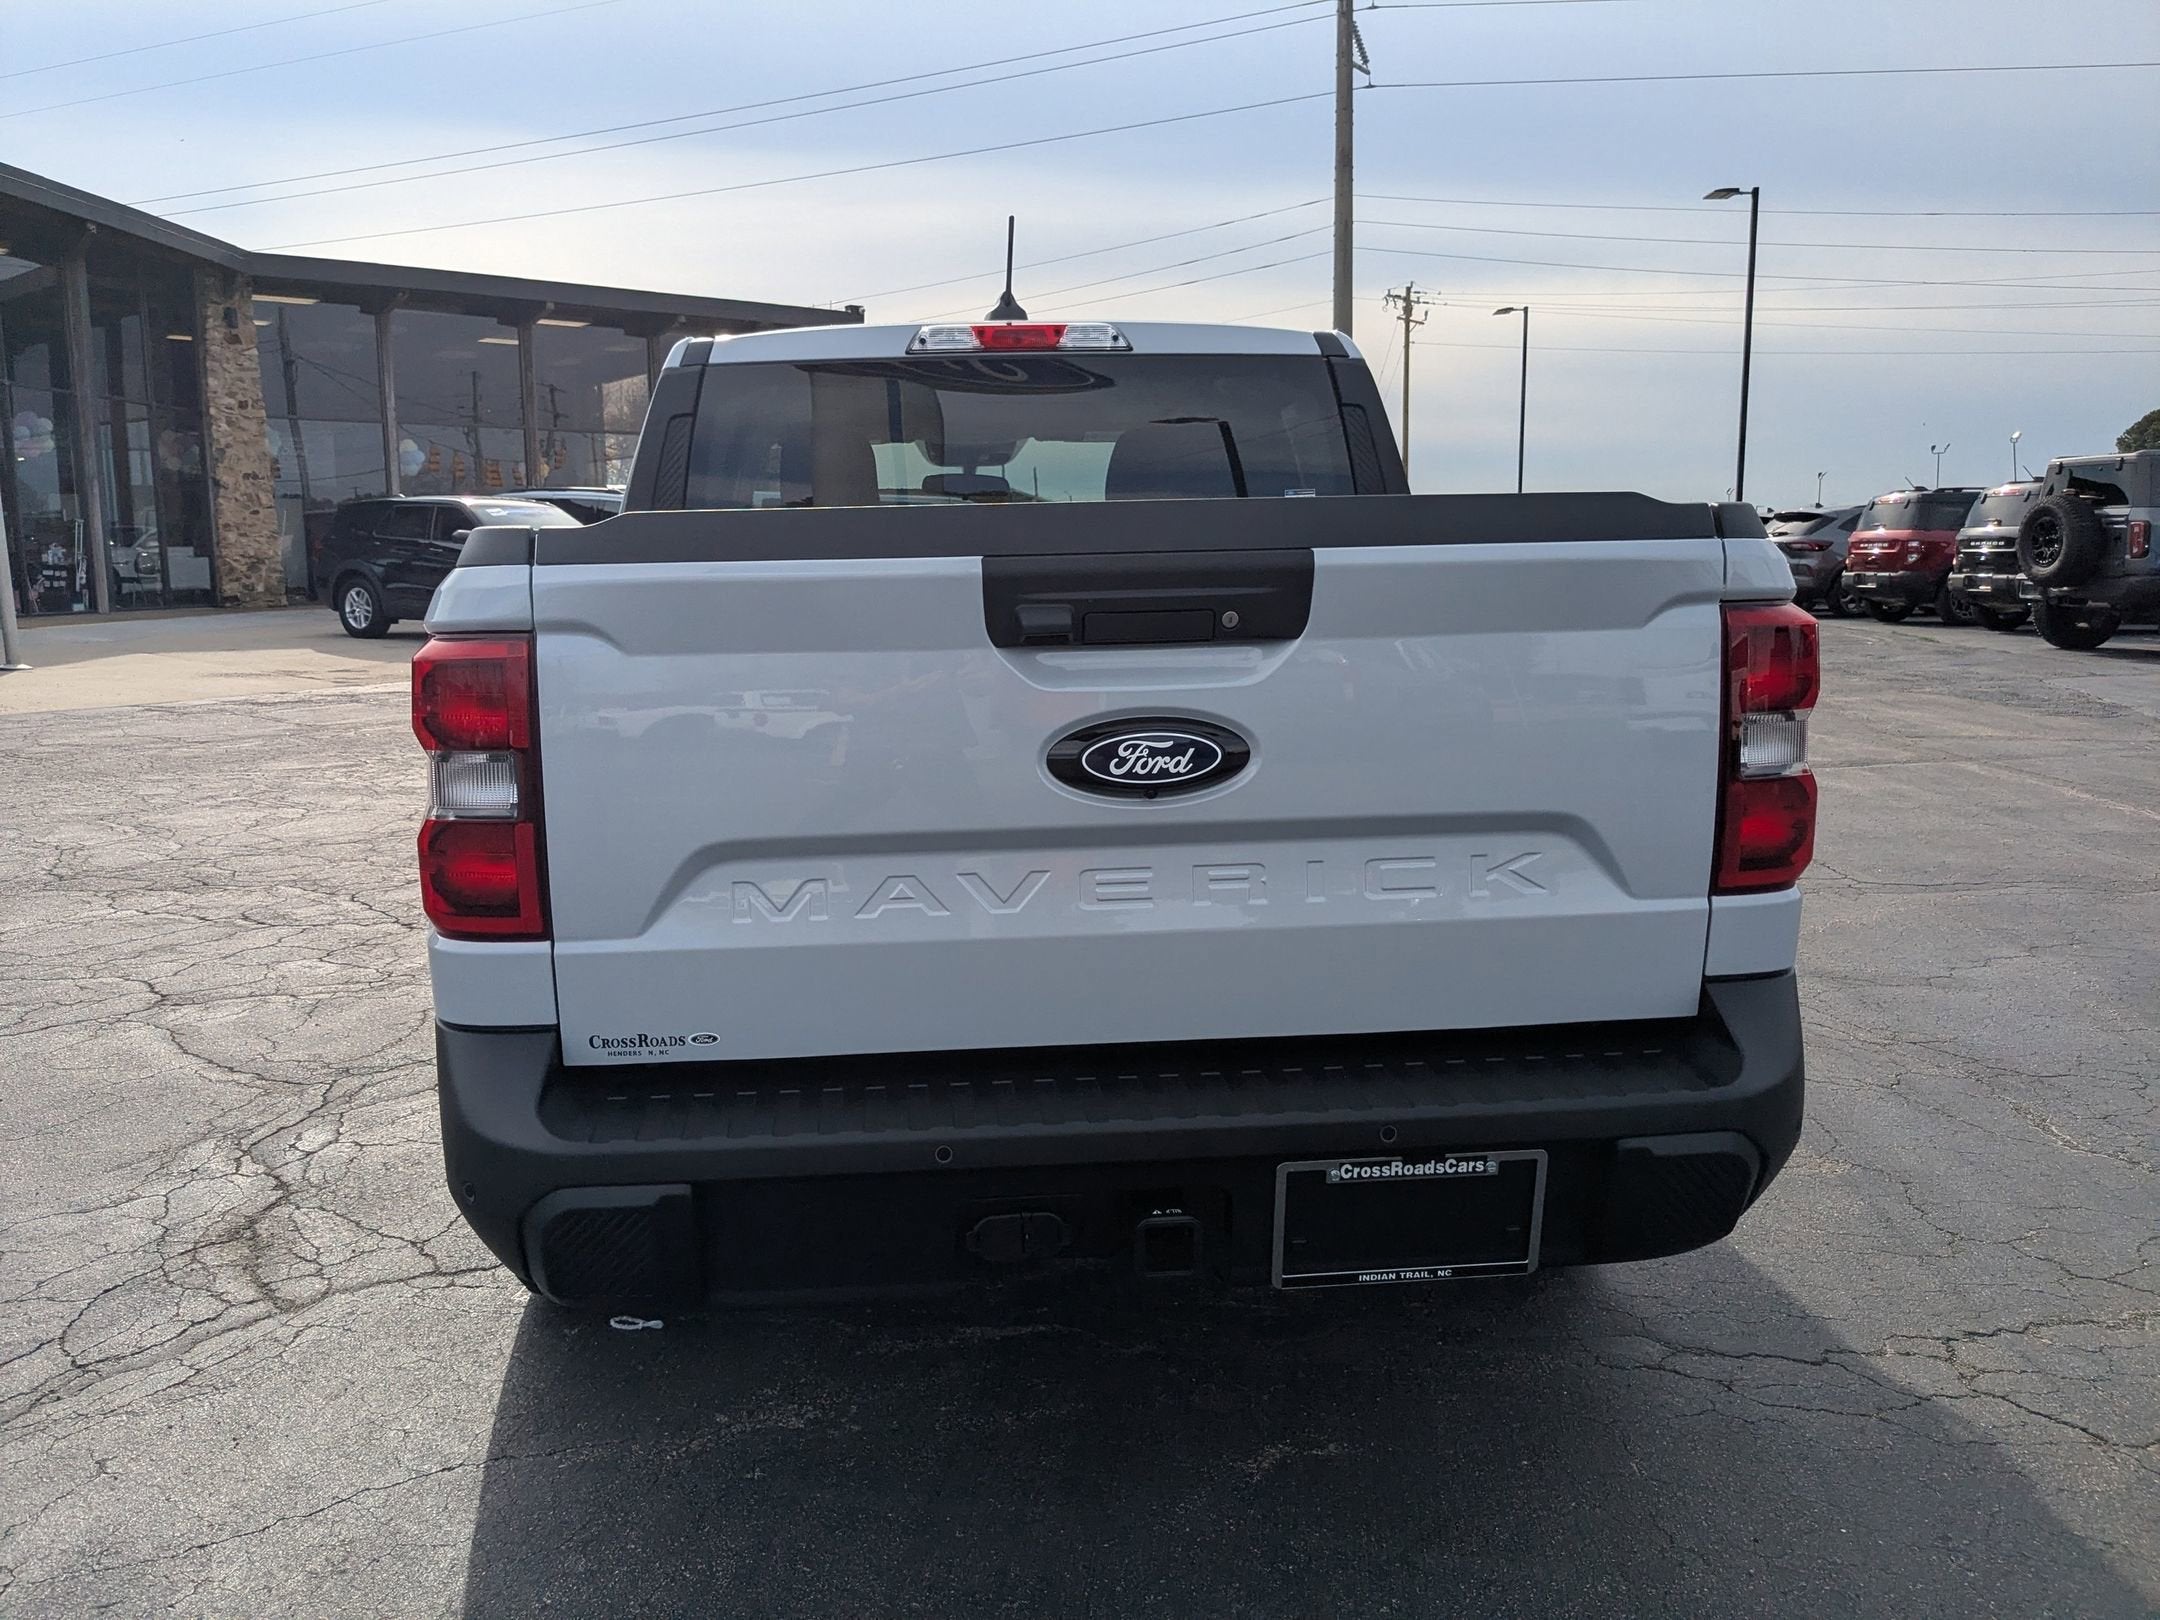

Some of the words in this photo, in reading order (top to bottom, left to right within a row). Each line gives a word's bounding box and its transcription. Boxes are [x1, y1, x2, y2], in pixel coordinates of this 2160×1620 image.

[1109, 740, 1196, 775] Ford
[731, 851, 1547, 924] MAVERICK
[1340, 1158, 1485, 1180] CrossRoadsCars
[1358, 1273, 1396, 1282] INDIAN
[1400, 1271, 1434, 1279] TRAIL,
[1437, 1269, 1453, 1277] NC
